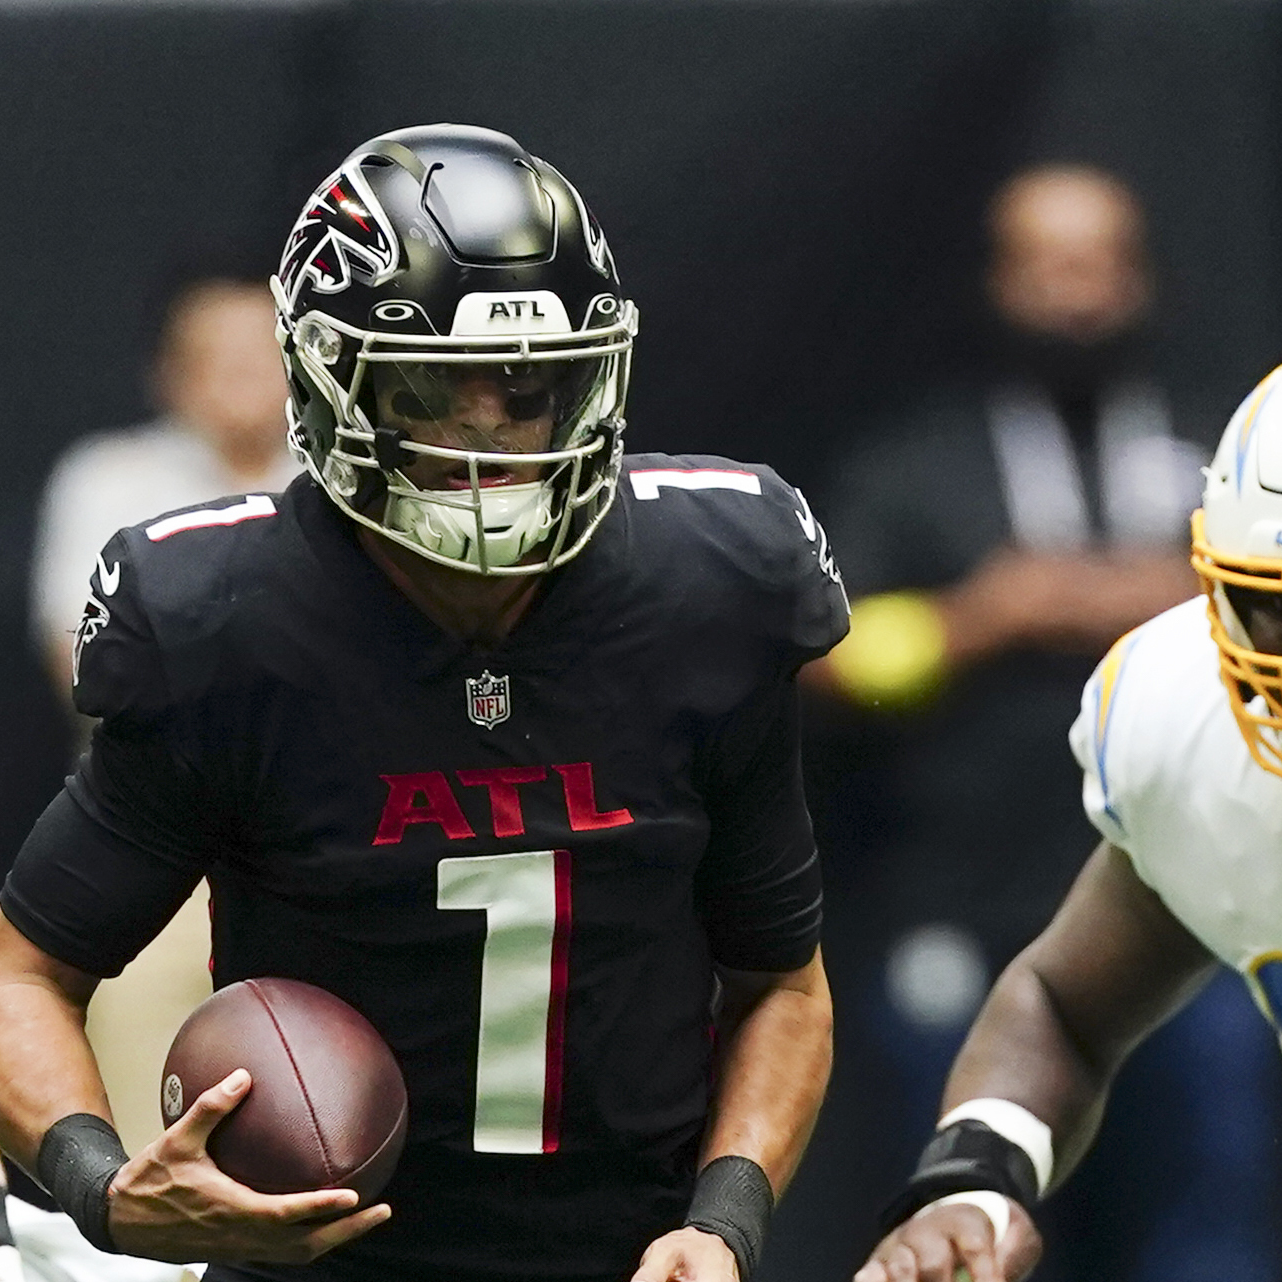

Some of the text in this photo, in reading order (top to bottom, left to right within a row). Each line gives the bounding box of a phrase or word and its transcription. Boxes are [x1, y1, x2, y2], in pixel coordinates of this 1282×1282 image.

[487, 300, 545, 319] ATL
[628, 467, 763, 500] 1
[474, 696, 504, 719] NFL
[371, 762, 635, 846] ATL
[436, 849, 572, 1154] 1
